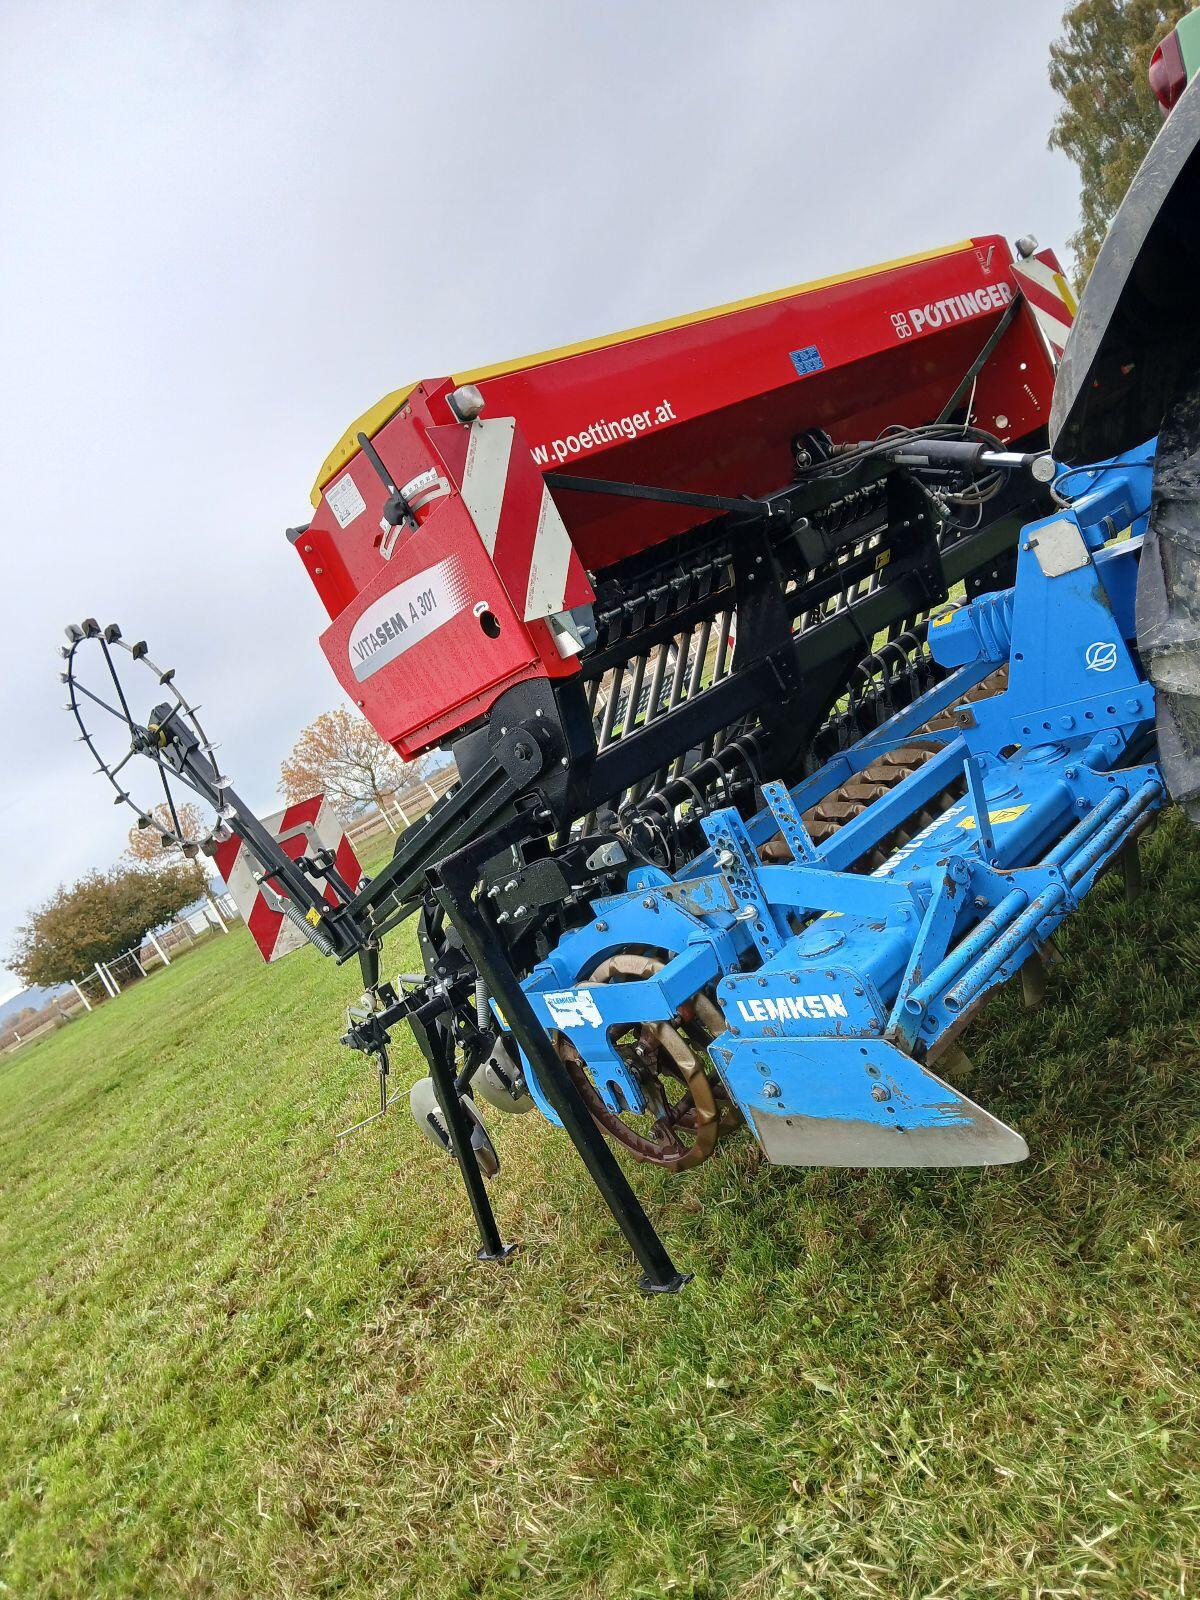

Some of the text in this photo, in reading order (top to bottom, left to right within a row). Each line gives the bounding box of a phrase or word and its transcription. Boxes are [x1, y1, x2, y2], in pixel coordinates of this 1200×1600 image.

[908, 282, 1013, 333] PÖTTINGER
[353, 587, 438, 660] VITASEM A 301
[736, 993, 848, 1022] LEMKEN
